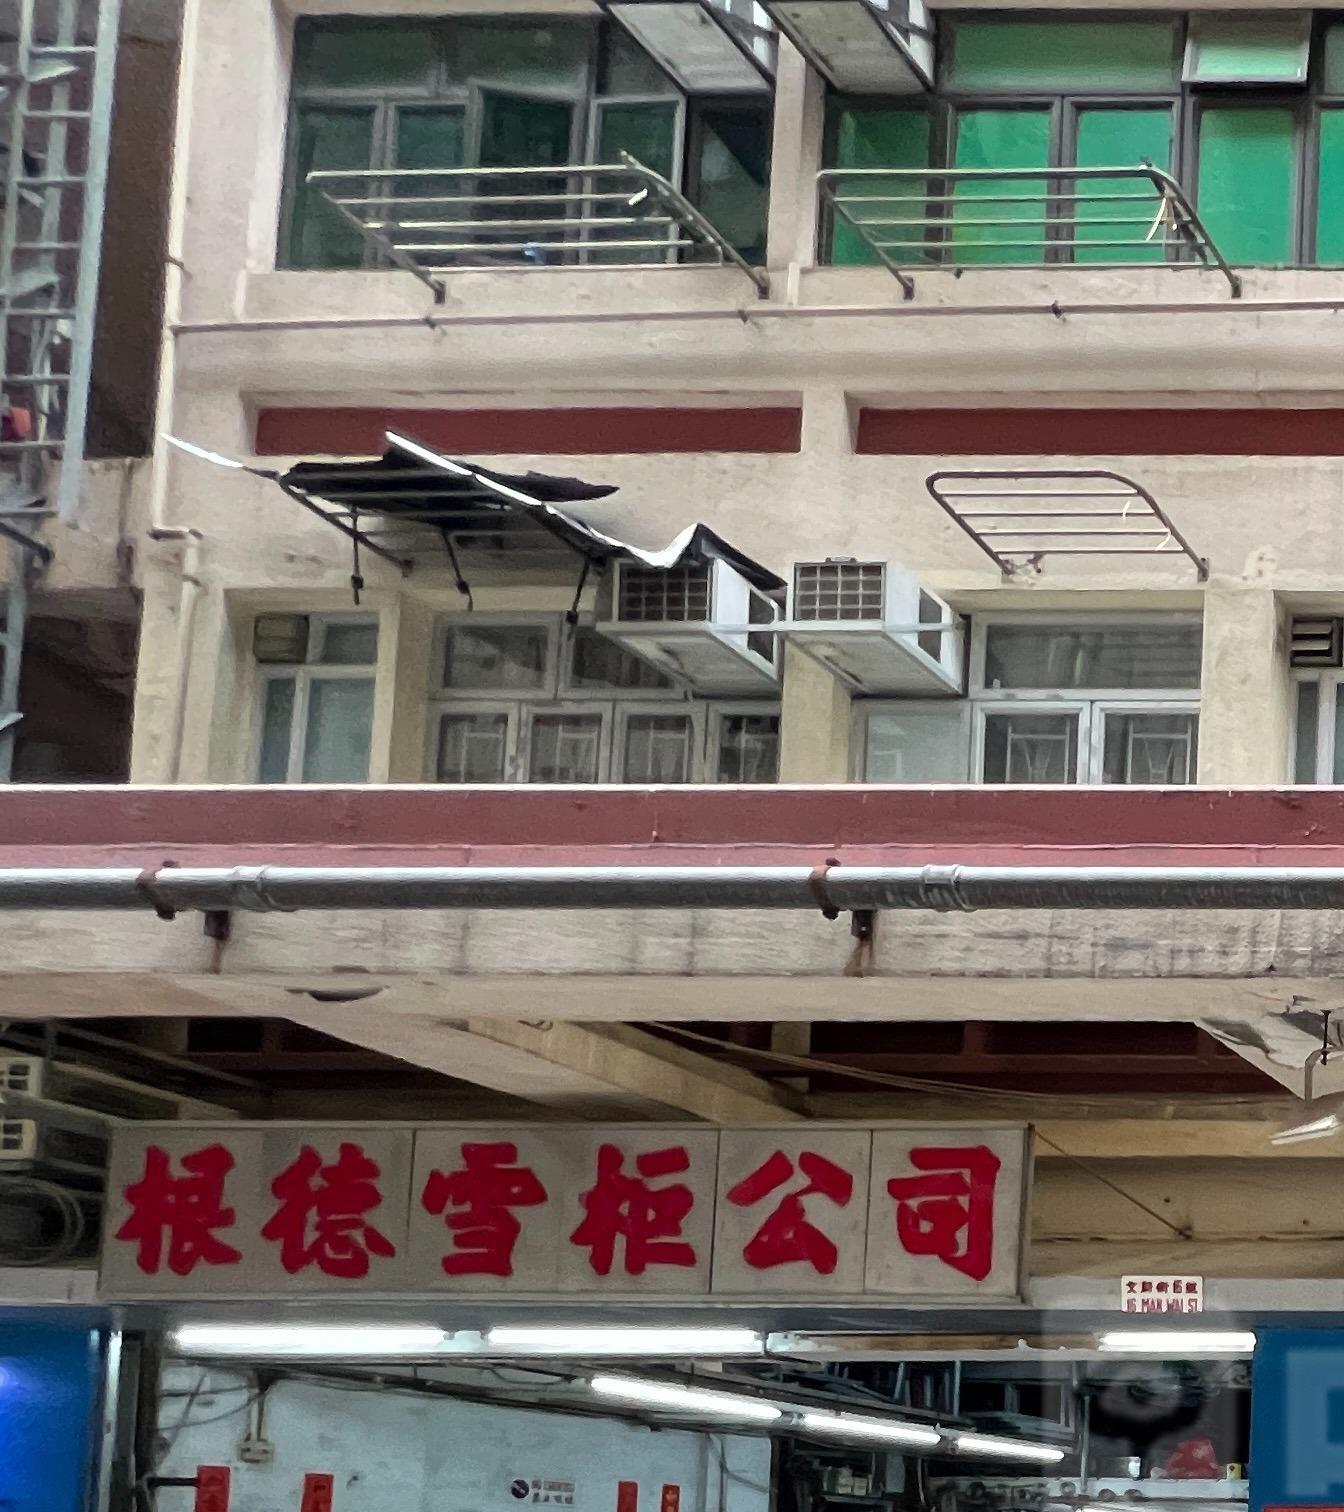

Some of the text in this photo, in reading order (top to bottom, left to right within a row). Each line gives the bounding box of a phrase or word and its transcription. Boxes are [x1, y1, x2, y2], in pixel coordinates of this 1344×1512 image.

[114, 1141, 1003, 1281] 根德雪柜公司
